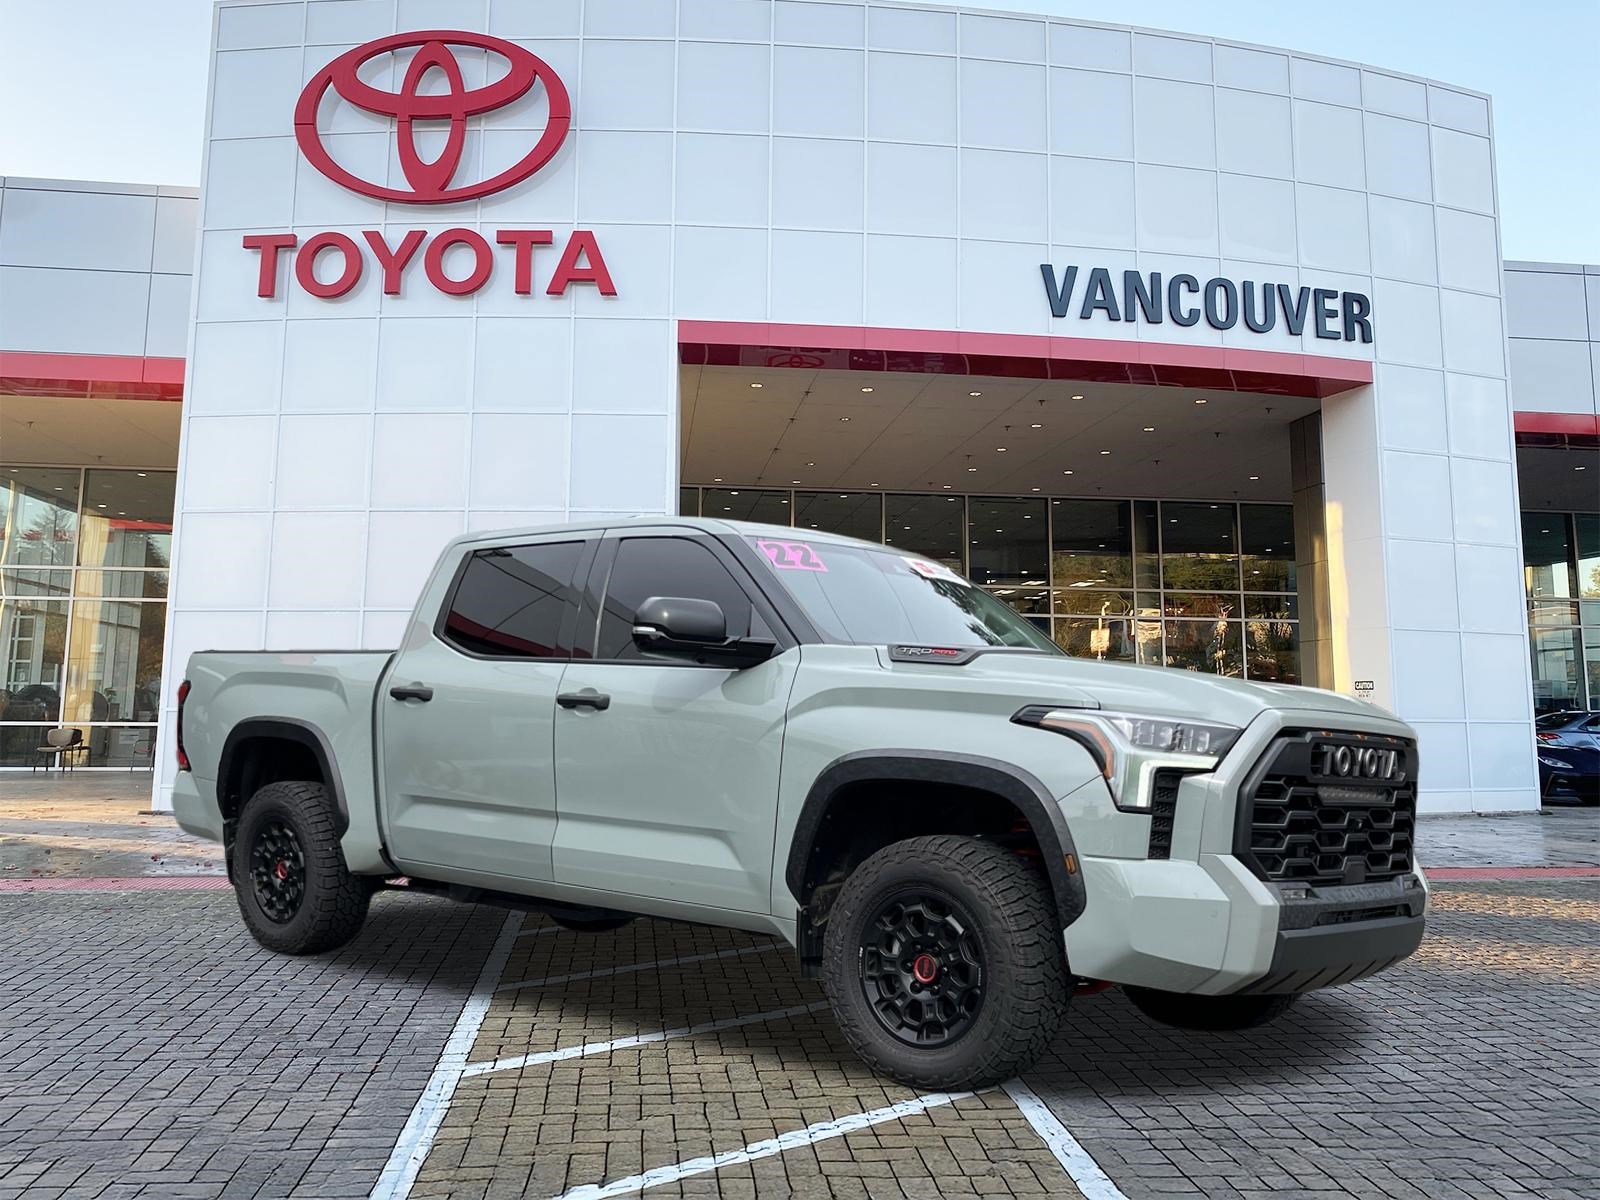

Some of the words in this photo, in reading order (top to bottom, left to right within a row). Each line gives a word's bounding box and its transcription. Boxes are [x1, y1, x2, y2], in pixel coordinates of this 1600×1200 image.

[243, 228, 618, 299] TOYOTA
[1040, 264, 1373, 344] VANCOUVER
[762, 543, 821, 568] 22
[1321, 744, 1399, 778] TOYOTA
